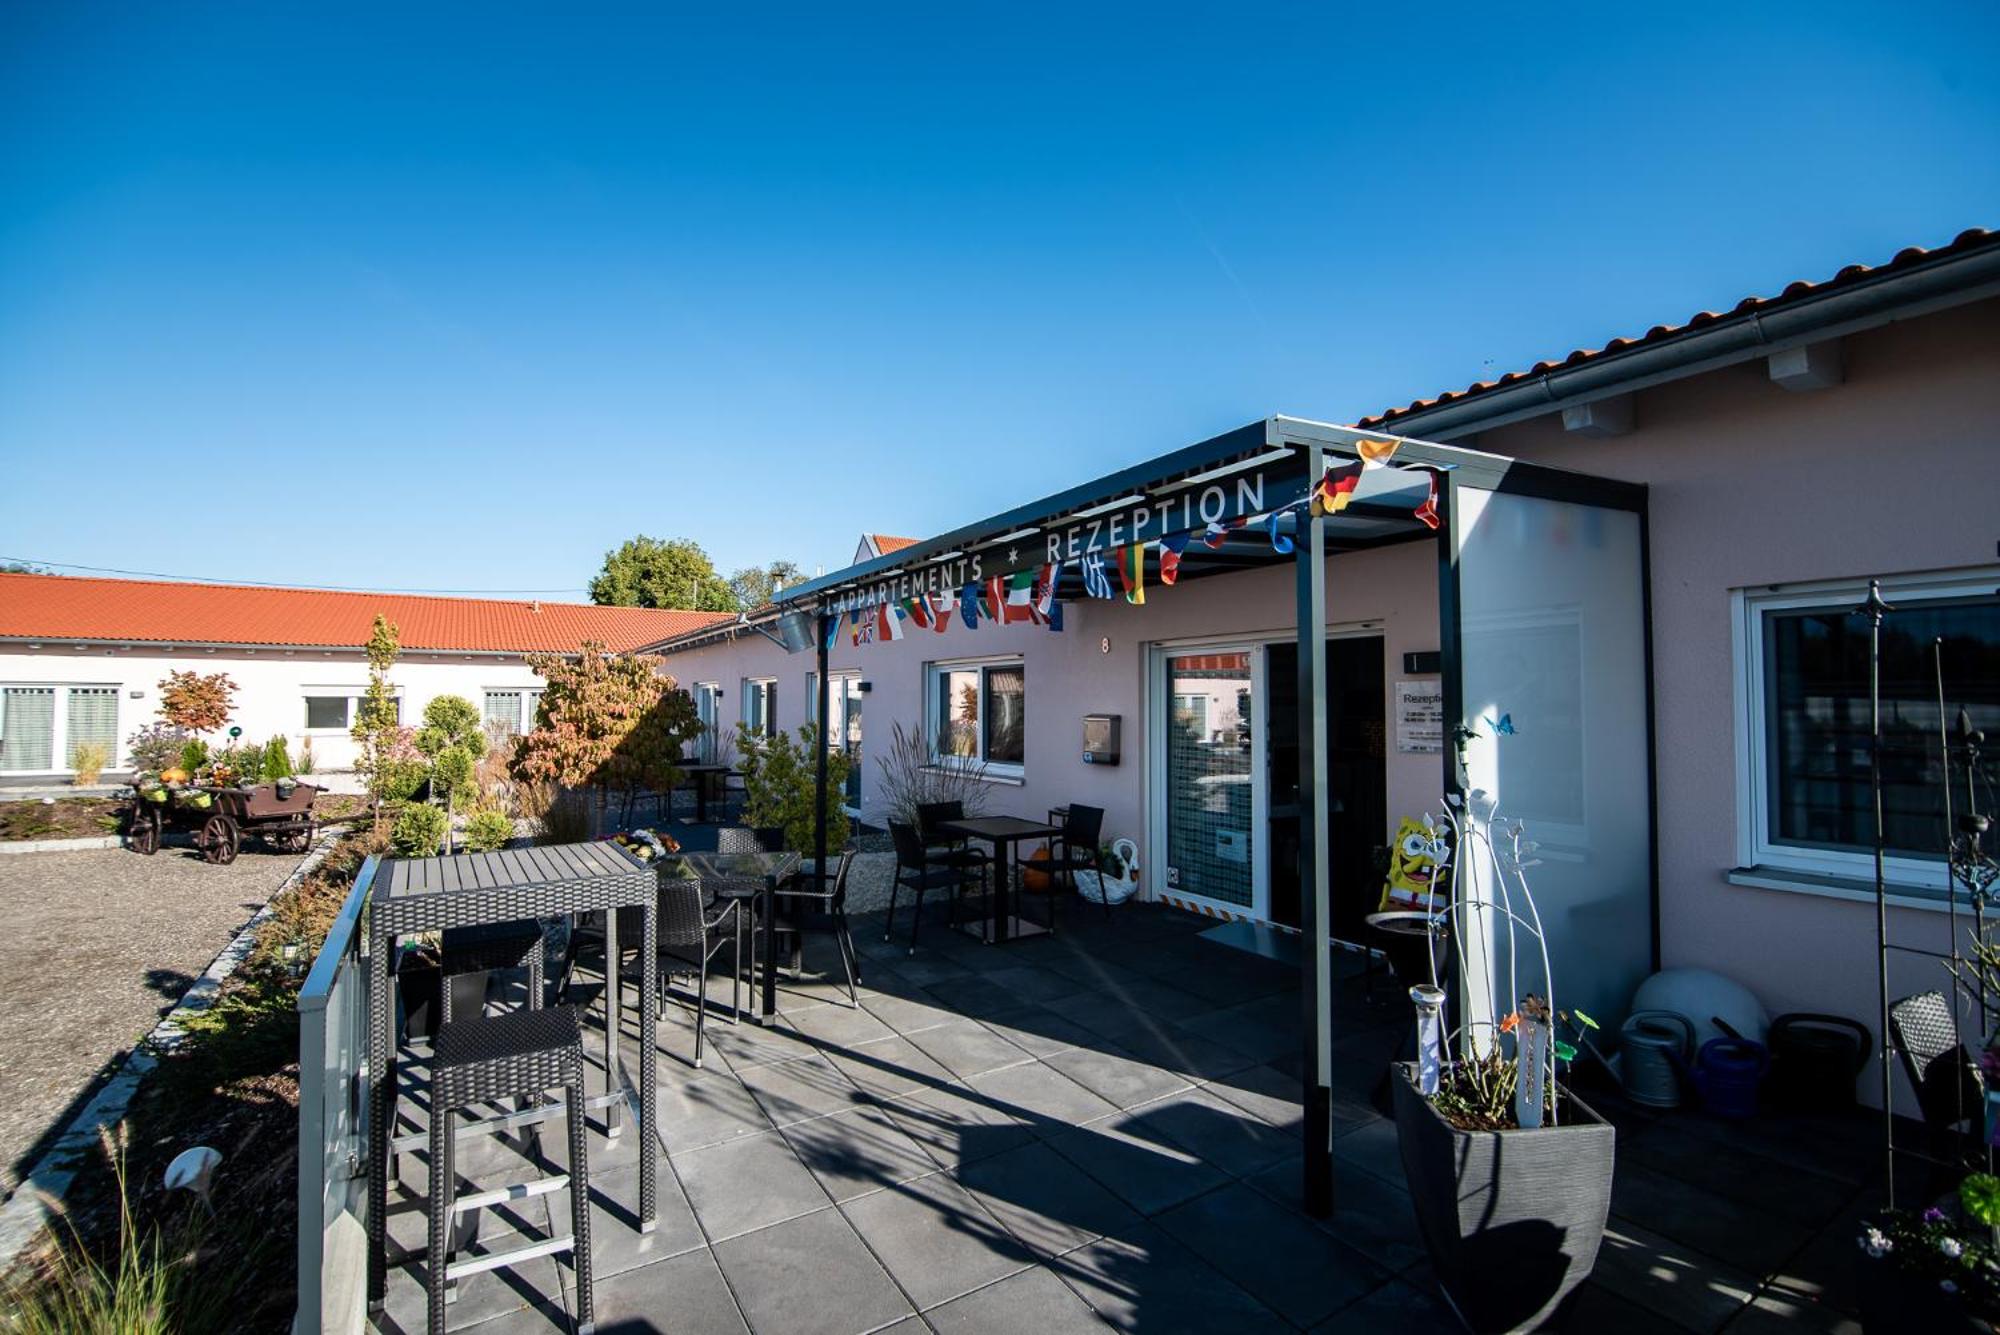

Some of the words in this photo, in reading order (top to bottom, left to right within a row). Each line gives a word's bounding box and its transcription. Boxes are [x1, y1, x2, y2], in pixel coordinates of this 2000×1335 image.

[1047, 472, 1264, 563] REZEPTION
[1102, 637, 1109, 653] 8
[1403, 694, 1442, 704] Rezepti
